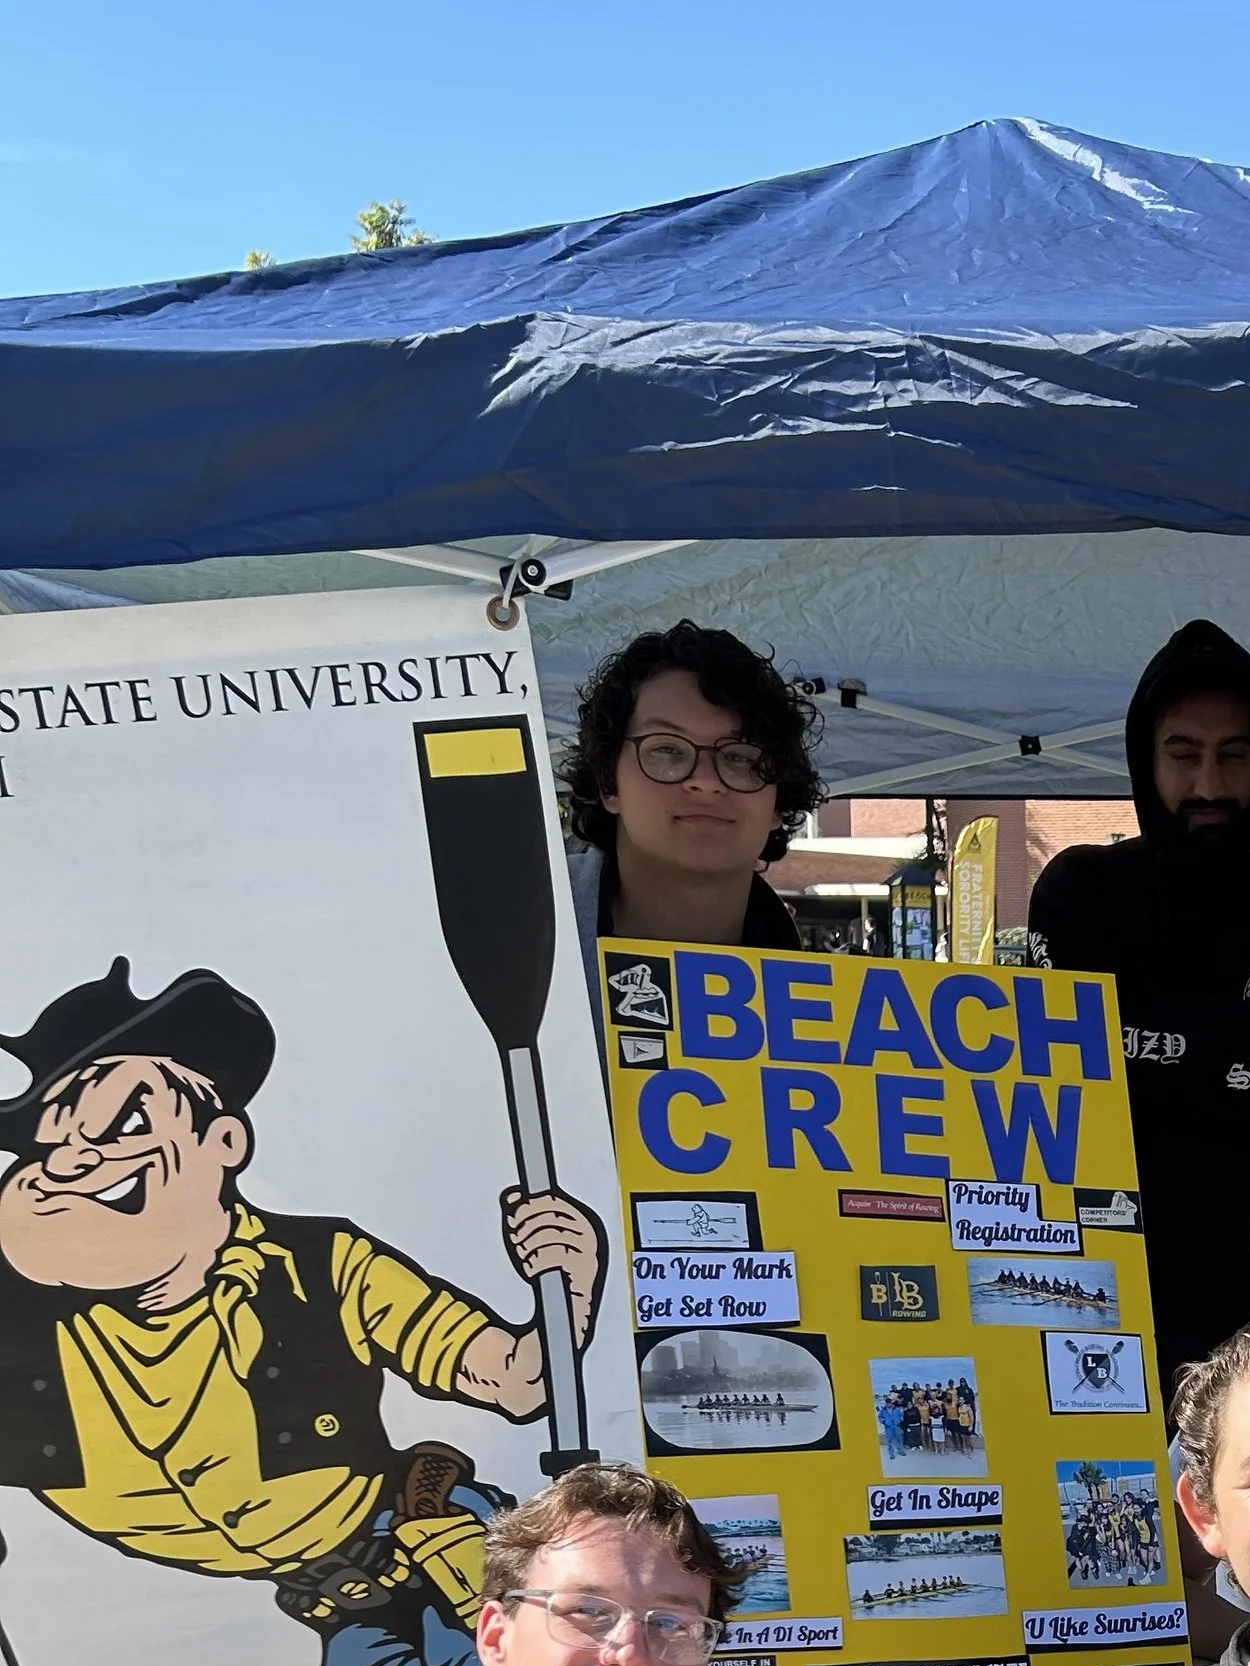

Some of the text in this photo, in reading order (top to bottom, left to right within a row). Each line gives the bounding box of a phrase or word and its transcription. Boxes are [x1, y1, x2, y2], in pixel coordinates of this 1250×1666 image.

[0, 650, 530, 733] STATE UNIVERSITY,
[958, 860, 971, 935] SORORITY
[673, 950, 1112, 1082] BEACH
[638, 1067, 1083, 1185] CREW
[952, 1182, 1030, 1213] Priority
[956, 1218, 1077, 1247] Registration
[1081, 1216, 1109, 1224] CORNER
[633, 1255, 793, 1282] On Your Mark
[892, 1271, 924, 1310] LB
[636, 1294, 768, 1319] Get Set Row
[891, 1309, 927, 1319] ROWING
[870, 1485, 999, 1518] Get In Shape
[735, 1627, 753, 1644] In
[756, 1626, 771, 1645] A
[773, 1625, 793, 1642] D1
[797, 1625, 838, 1646] Sport
[1025, 1607, 1185, 1643] U Like Sunrises?
[760, 1658, 771, 1666] IN
